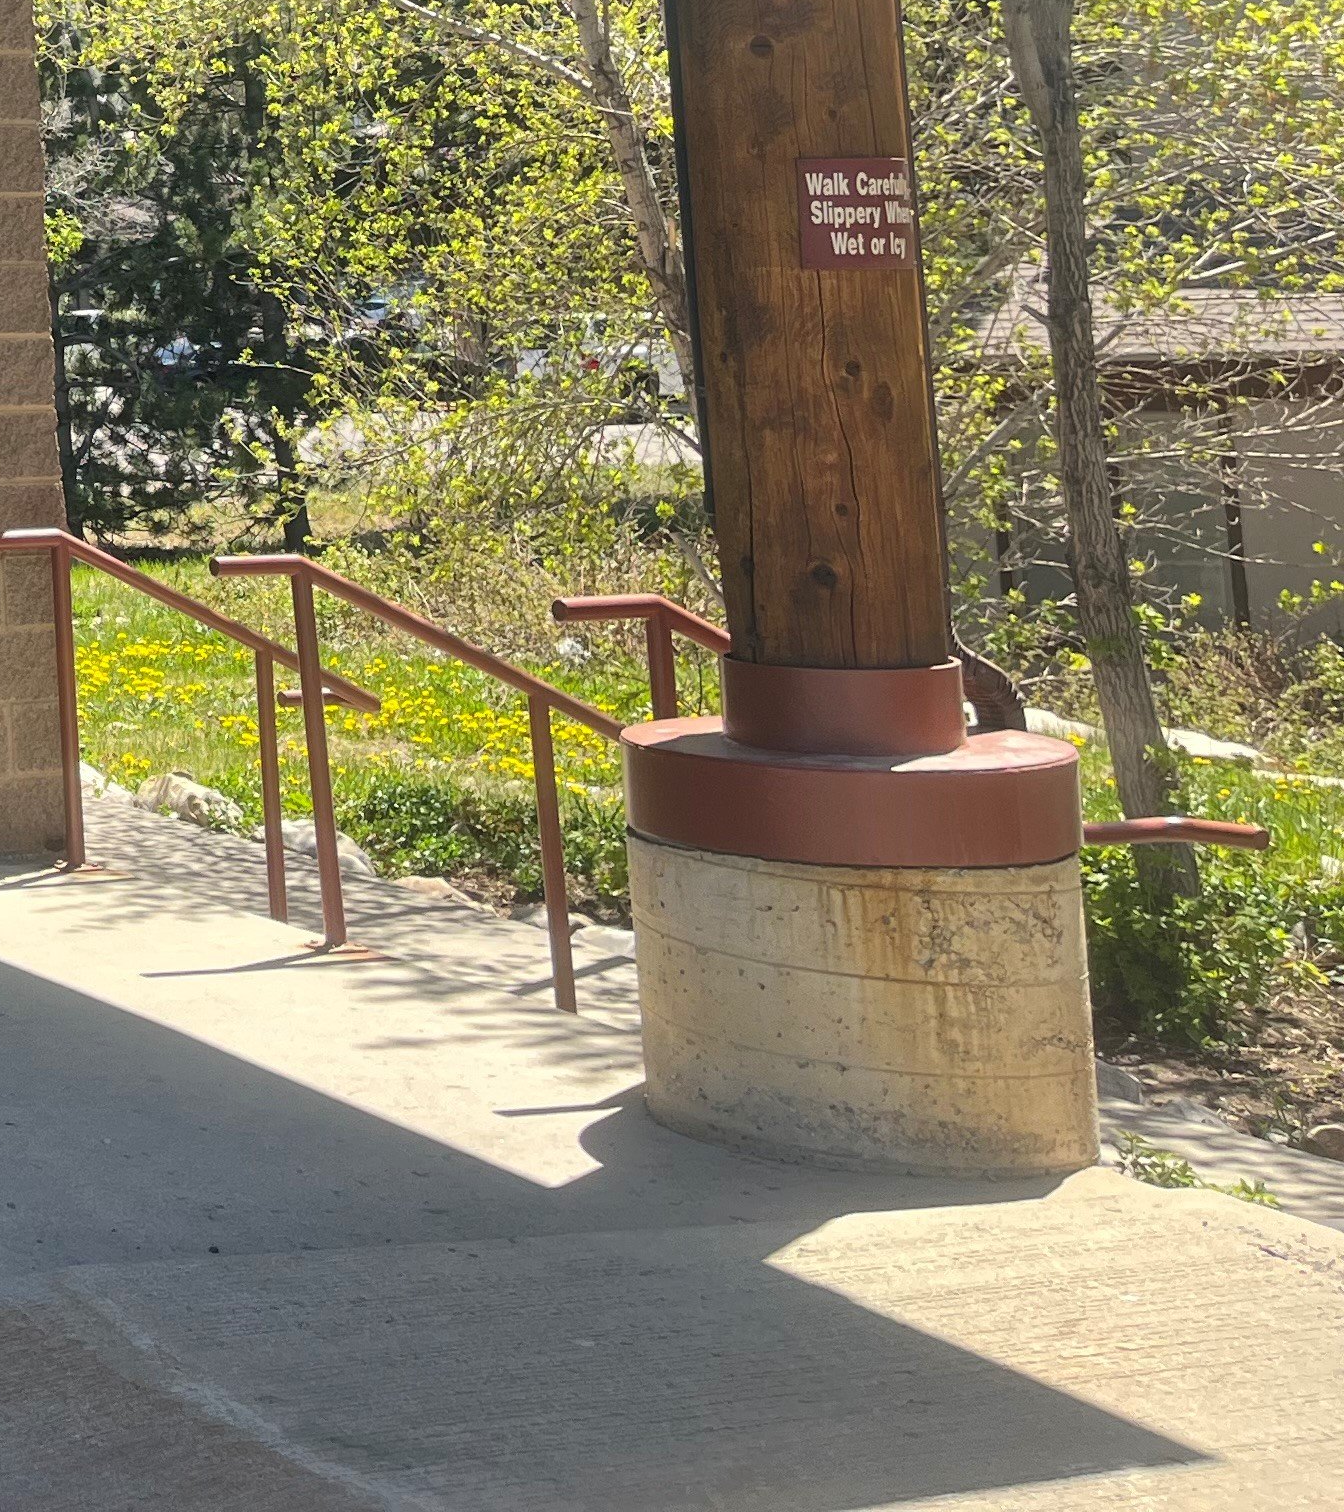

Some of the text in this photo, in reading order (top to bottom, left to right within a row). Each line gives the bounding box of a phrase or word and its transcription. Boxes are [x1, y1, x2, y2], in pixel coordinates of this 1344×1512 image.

[805, 172, 850, 196] Walk
[811, 200, 881, 228] Slippery
[830, 231, 906, 260] Wet or Icy
